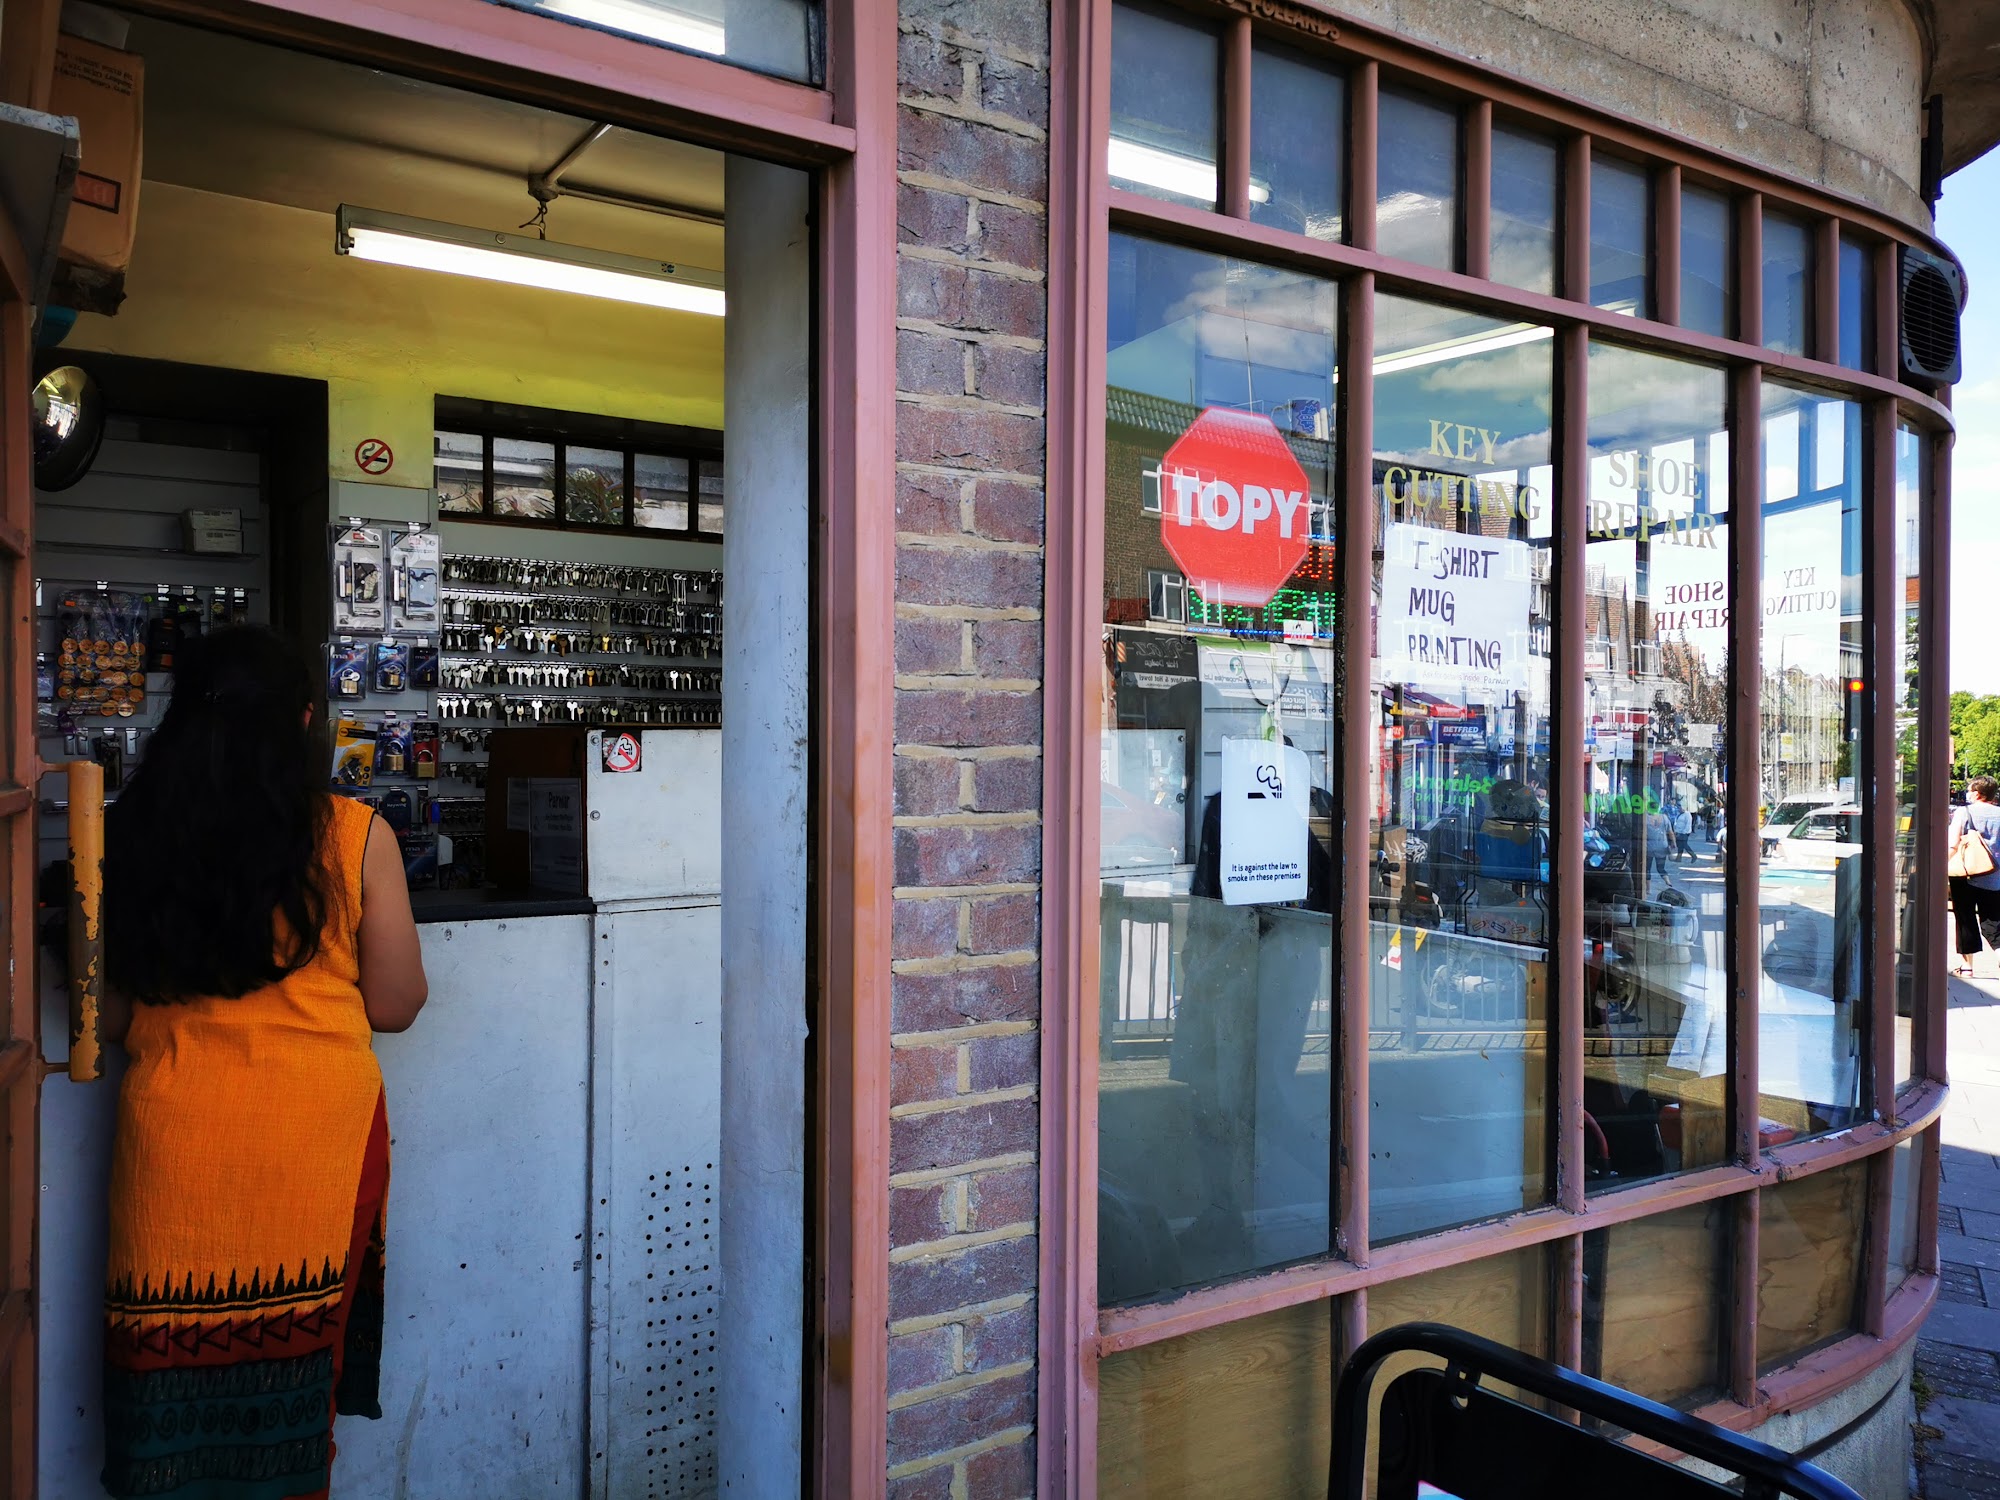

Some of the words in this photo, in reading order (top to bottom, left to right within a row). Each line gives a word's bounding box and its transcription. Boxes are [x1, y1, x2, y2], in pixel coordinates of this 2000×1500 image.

[1428, 419, 1501, 466] KEY
[1384, 467, 1541, 520] CUTTING
[1609, 450, 1702, 499] SHOE
[1172, 475, 1303, 539] TOPY
[1590, 500, 1718, 549] REPAIR
[1413, 541, 1499, 580] T-SHIRT
[1408, 587, 1455, 626] MUG
[1408, 634, 1502, 674] PRINTING
[1442, 726, 1479, 734] BETFRED
[1228, 874, 1248, 882] smoke
[1256, 873, 1273, 881] these
[1274, 871, 1301, 882] premises
[1232, 864, 1237, 872] It
[1244, 863, 1267, 873] against
[1279, 862, 1290, 870] law
